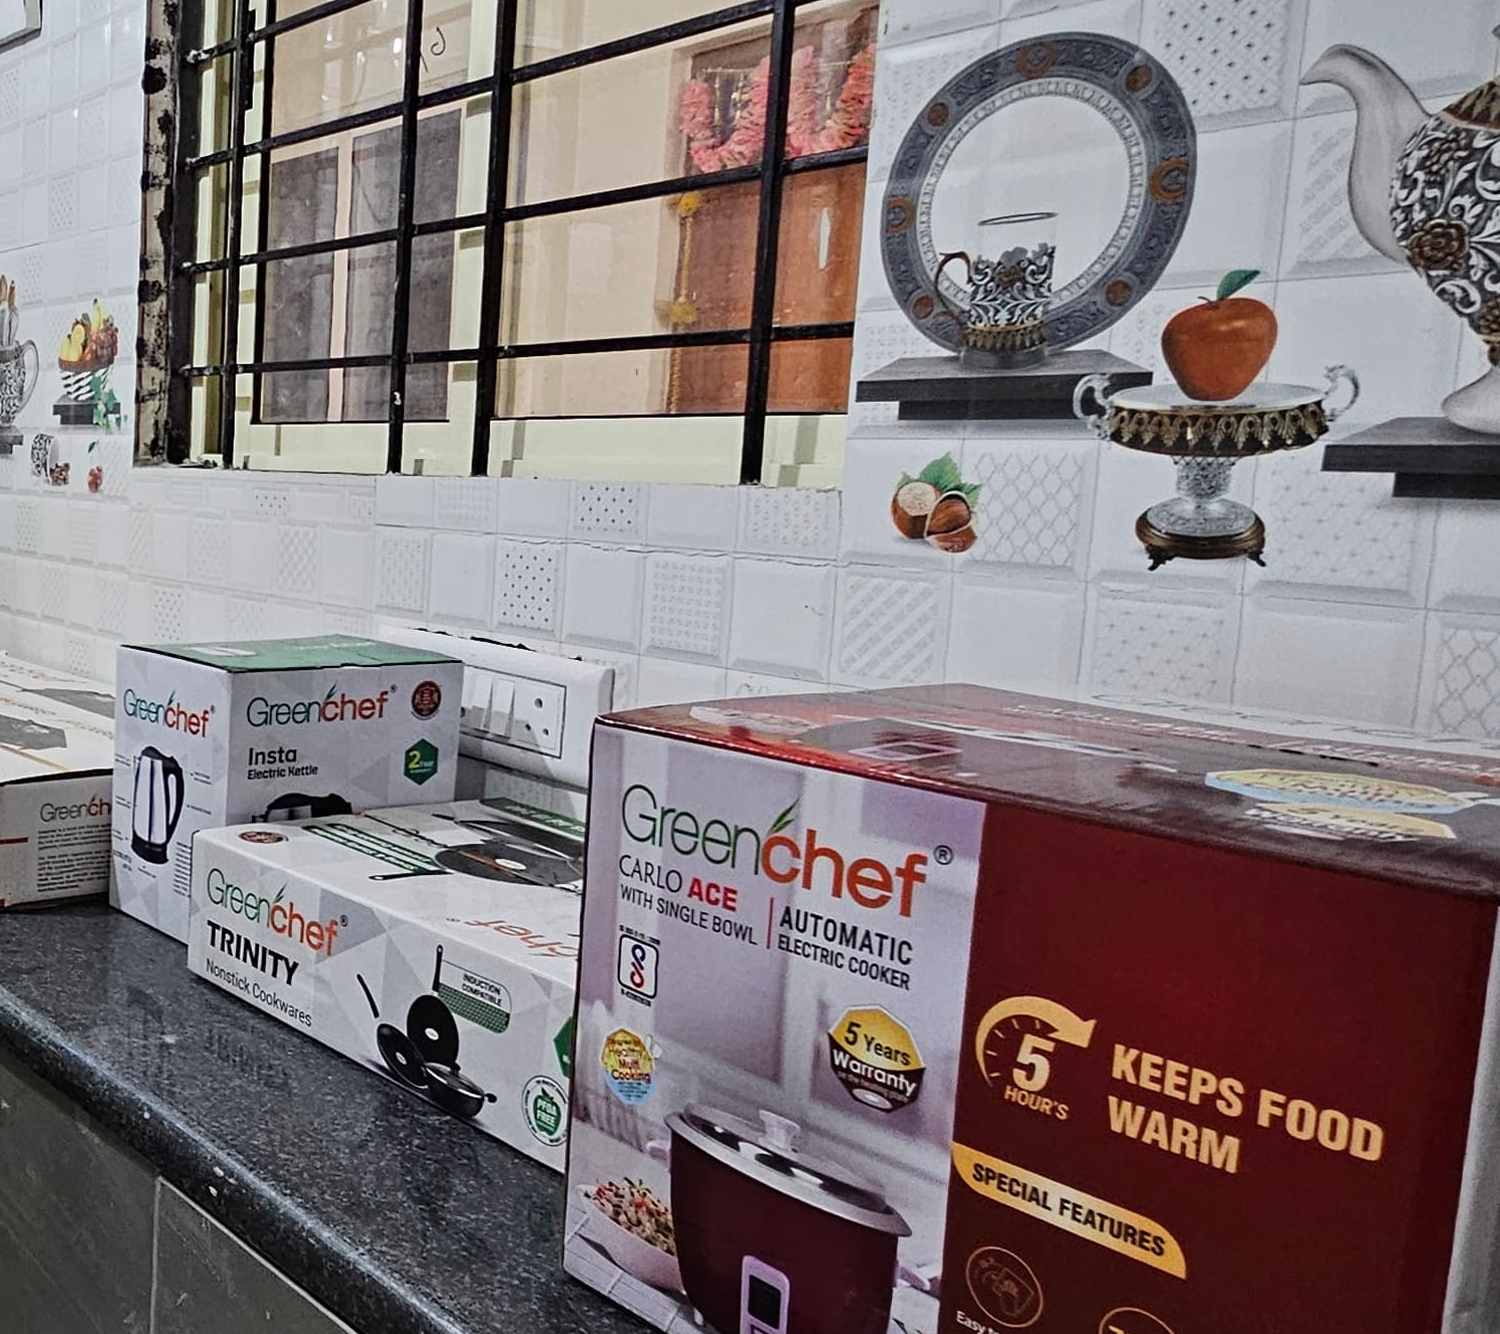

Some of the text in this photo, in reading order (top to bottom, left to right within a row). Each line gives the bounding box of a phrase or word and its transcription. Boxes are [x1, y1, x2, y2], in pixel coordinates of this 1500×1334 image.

[123, 689, 210, 738] Greenchef
[247, 685, 390, 727] Greenchef
[247, 765, 319, 780] Electric Kettle
[248, 746, 298, 766] Insta
[408, 750, 421, 769] 2
[40, 796, 112, 823] Greench
[621, 783, 929, 918] Greenchef
[206, 867, 339, 956] Greenchef
[619, 854, 739, 912] CARLO ACE
[620, 882, 759, 946] WITH SINGLE BOWL
[779, 905, 914, 966] AUTOMATIC
[206, 919, 300, 987] TRINITY
[777, 933, 911, 992] ELECTRIC COOKER
[206, 957, 313, 1028] Nonstick Cookwares
[462, 972, 502, 996] INDUCTION
[832, 1048, 917, 1097] Warranty
[843, 1021, 912, 1067] 5 Years
[1012, 1032, 1056, 1093] 5
[1004, 1084, 1071, 1121] HOUR'S
[1111, 1042, 1385, 1163] KEEPS FOOD
[1107, 1094, 1242, 1175] WARM
[972, 1162, 1167, 1258] SPECIAL FEATURES
